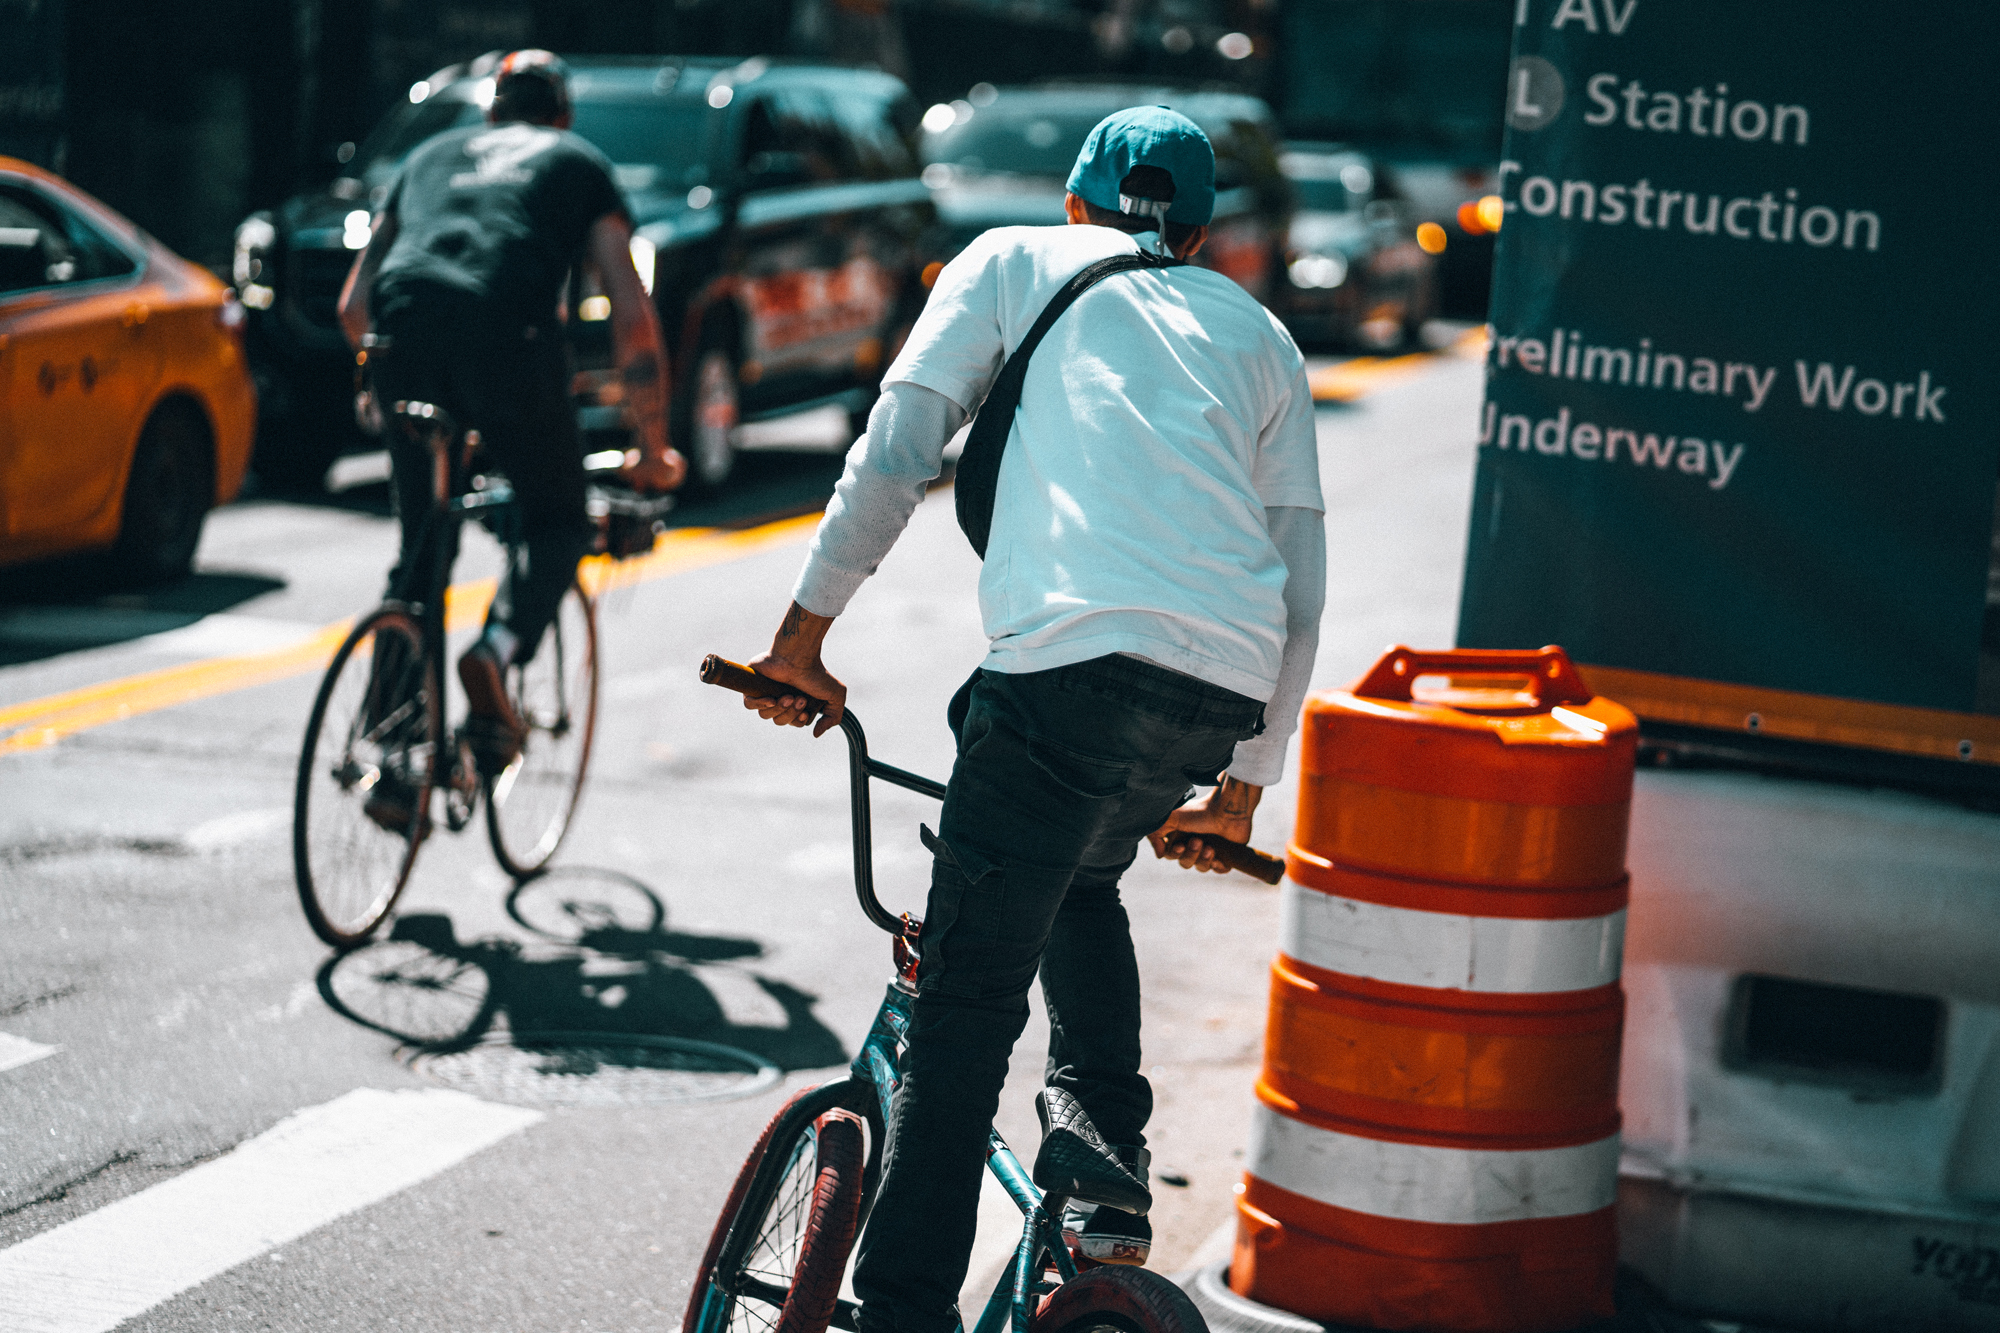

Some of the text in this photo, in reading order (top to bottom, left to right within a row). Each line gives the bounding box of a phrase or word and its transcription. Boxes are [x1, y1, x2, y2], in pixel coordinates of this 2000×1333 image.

[1514, 68, 1810, 145] L Station
[1795, 359, 1947, 423] Work
